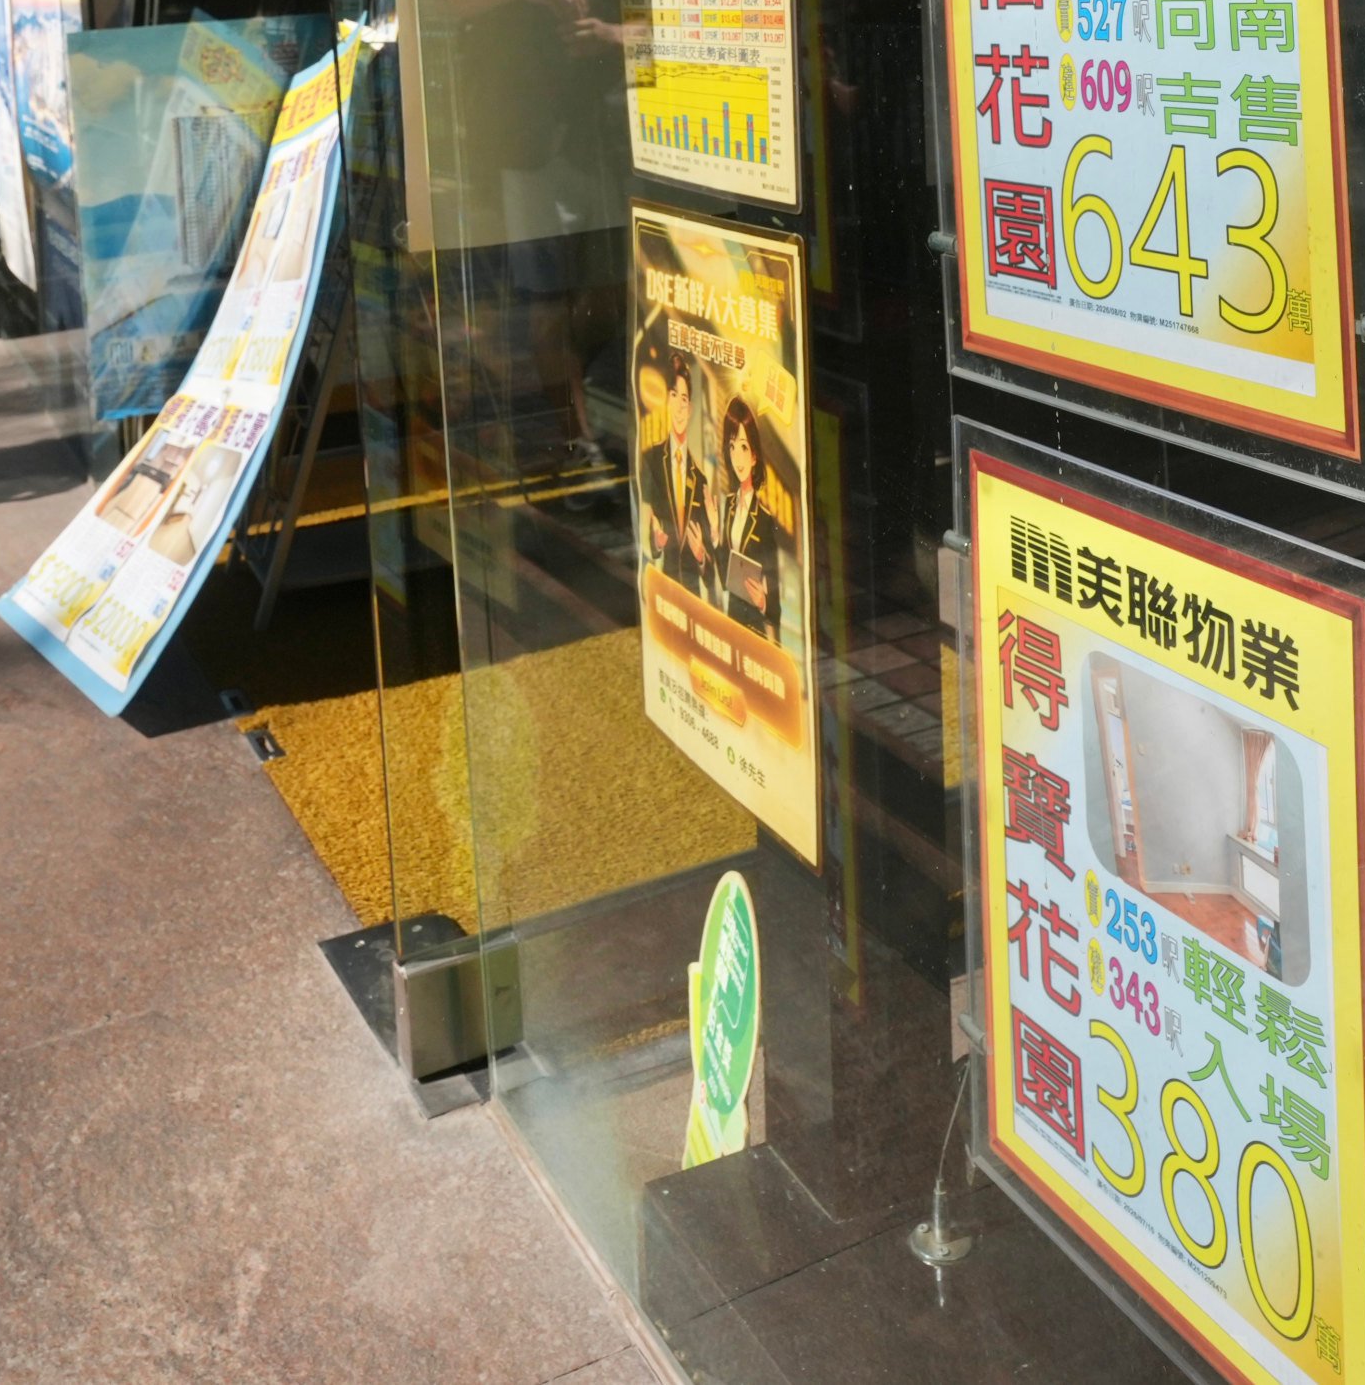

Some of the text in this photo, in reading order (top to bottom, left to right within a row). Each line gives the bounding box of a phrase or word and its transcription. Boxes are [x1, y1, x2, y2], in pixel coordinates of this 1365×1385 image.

[1080, 58, 1132, 113] 609
[1155, 71, 1303, 147] 吉售
[1060, 133, 1313, 336] 643 萬
[1075, 545, 1301, 712] 美聯物業
[996, 608, 1087, 1163] 得寶花園
[1105, 887, 1158, 965] 253
[1108, 955, 1162, 1037] 343
[1181, 935, 1328, 1089] 輕鬆
[1089, 1018, 1314, 1342] 380
[1187, 1030, 1331, 1181] 入場
